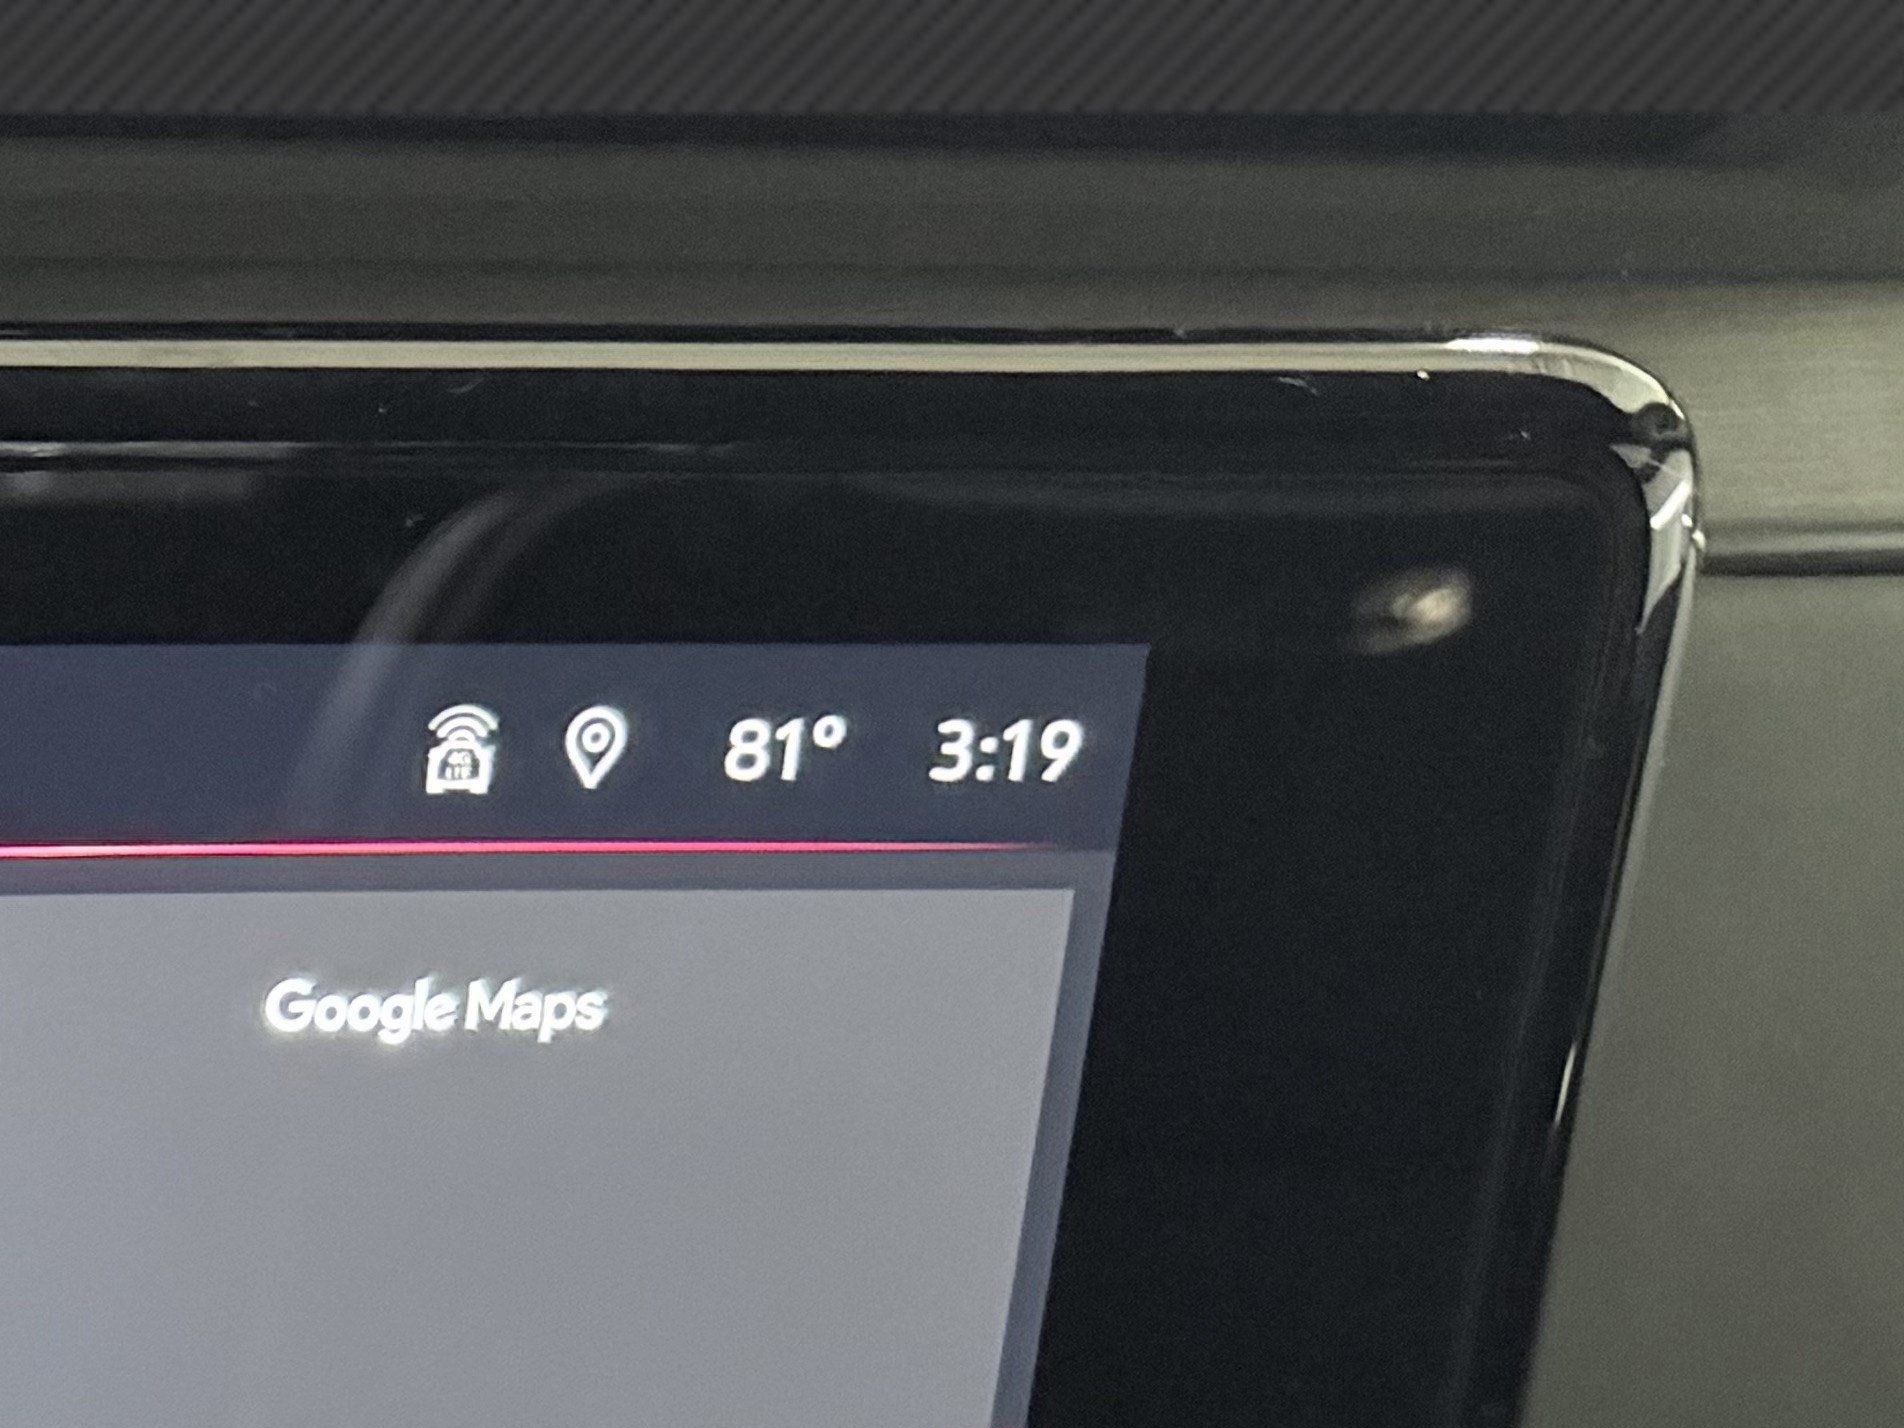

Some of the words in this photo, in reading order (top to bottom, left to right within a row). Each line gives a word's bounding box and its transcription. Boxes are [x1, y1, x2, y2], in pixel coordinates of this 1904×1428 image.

[928, 718, 1084, 784] 3:19
[264, 974, 459, 1045] Google
[463, 975, 609, 1043] Maps
